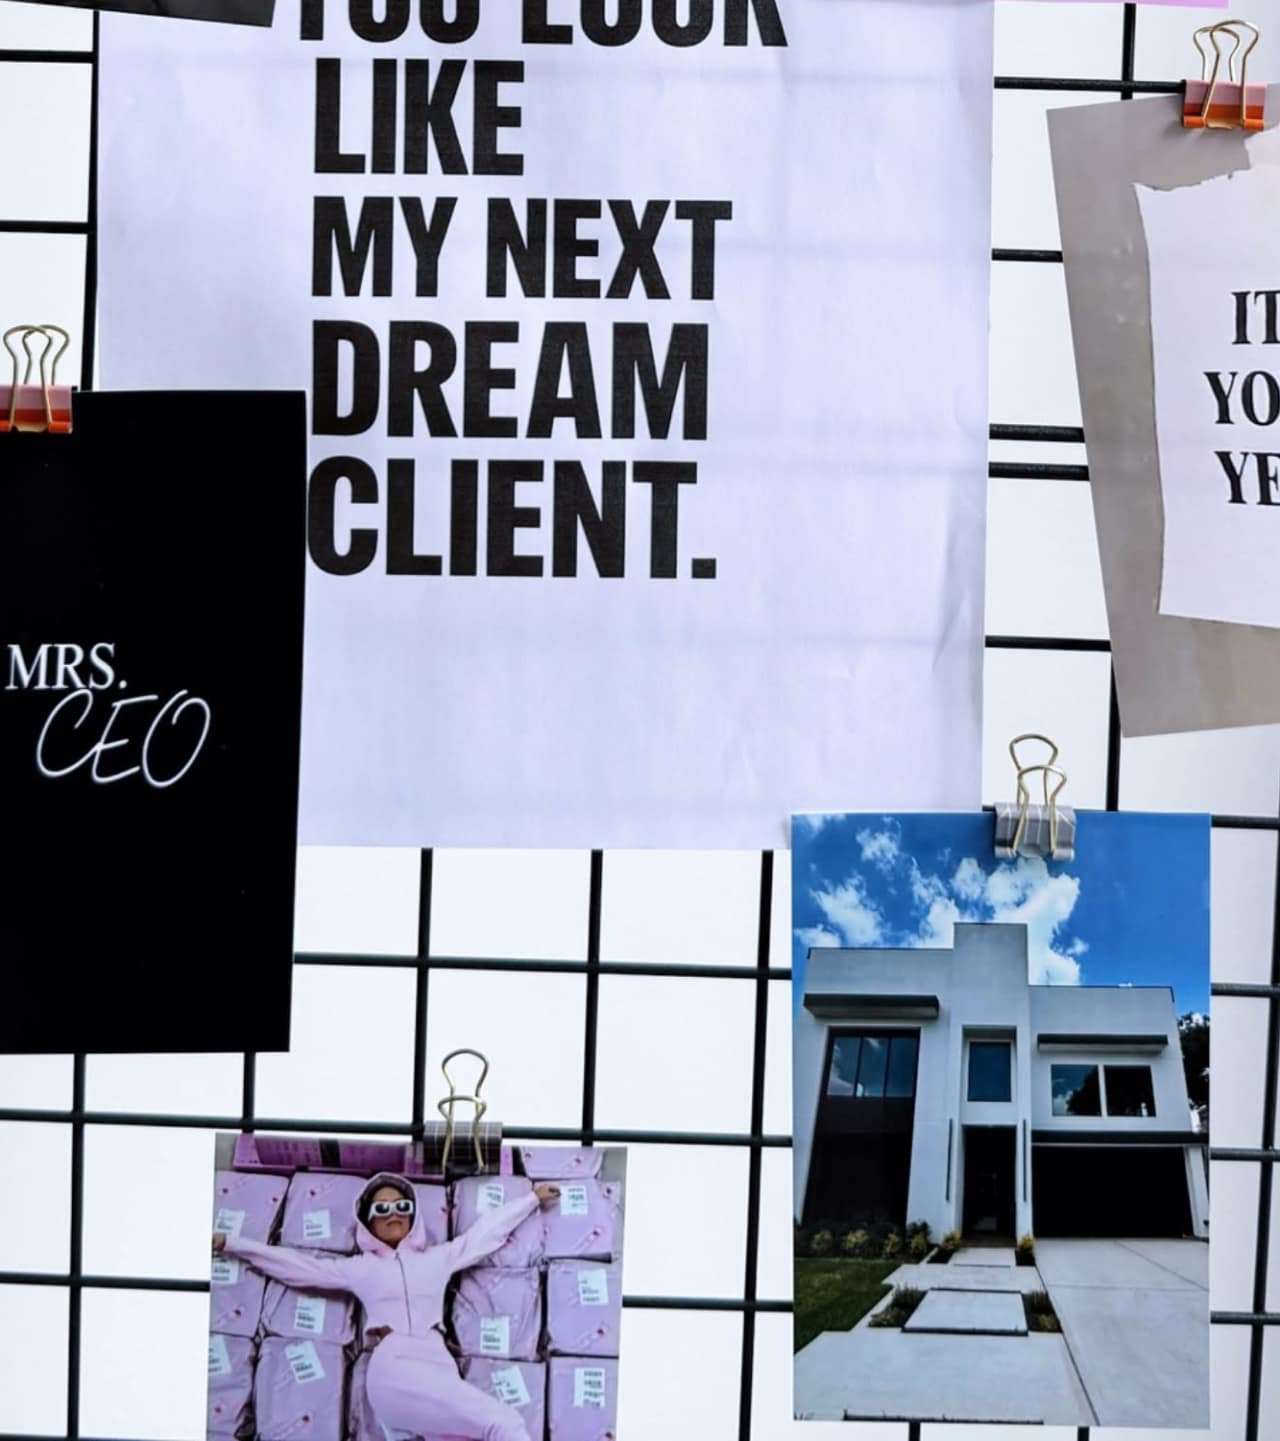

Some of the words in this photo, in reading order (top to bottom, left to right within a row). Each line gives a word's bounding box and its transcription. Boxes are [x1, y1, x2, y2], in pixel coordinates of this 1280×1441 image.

[314, 57, 525, 176] LIKE
[311, 196, 458, 298] MY
[486, 197, 733, 301] NEXT
[311, 319, 709, 441] DREAM
[306, 455, 717, 579] CLIENT.
[5, 642, 128, 690] MRS.
[36, 688, 211, 788] CEO
